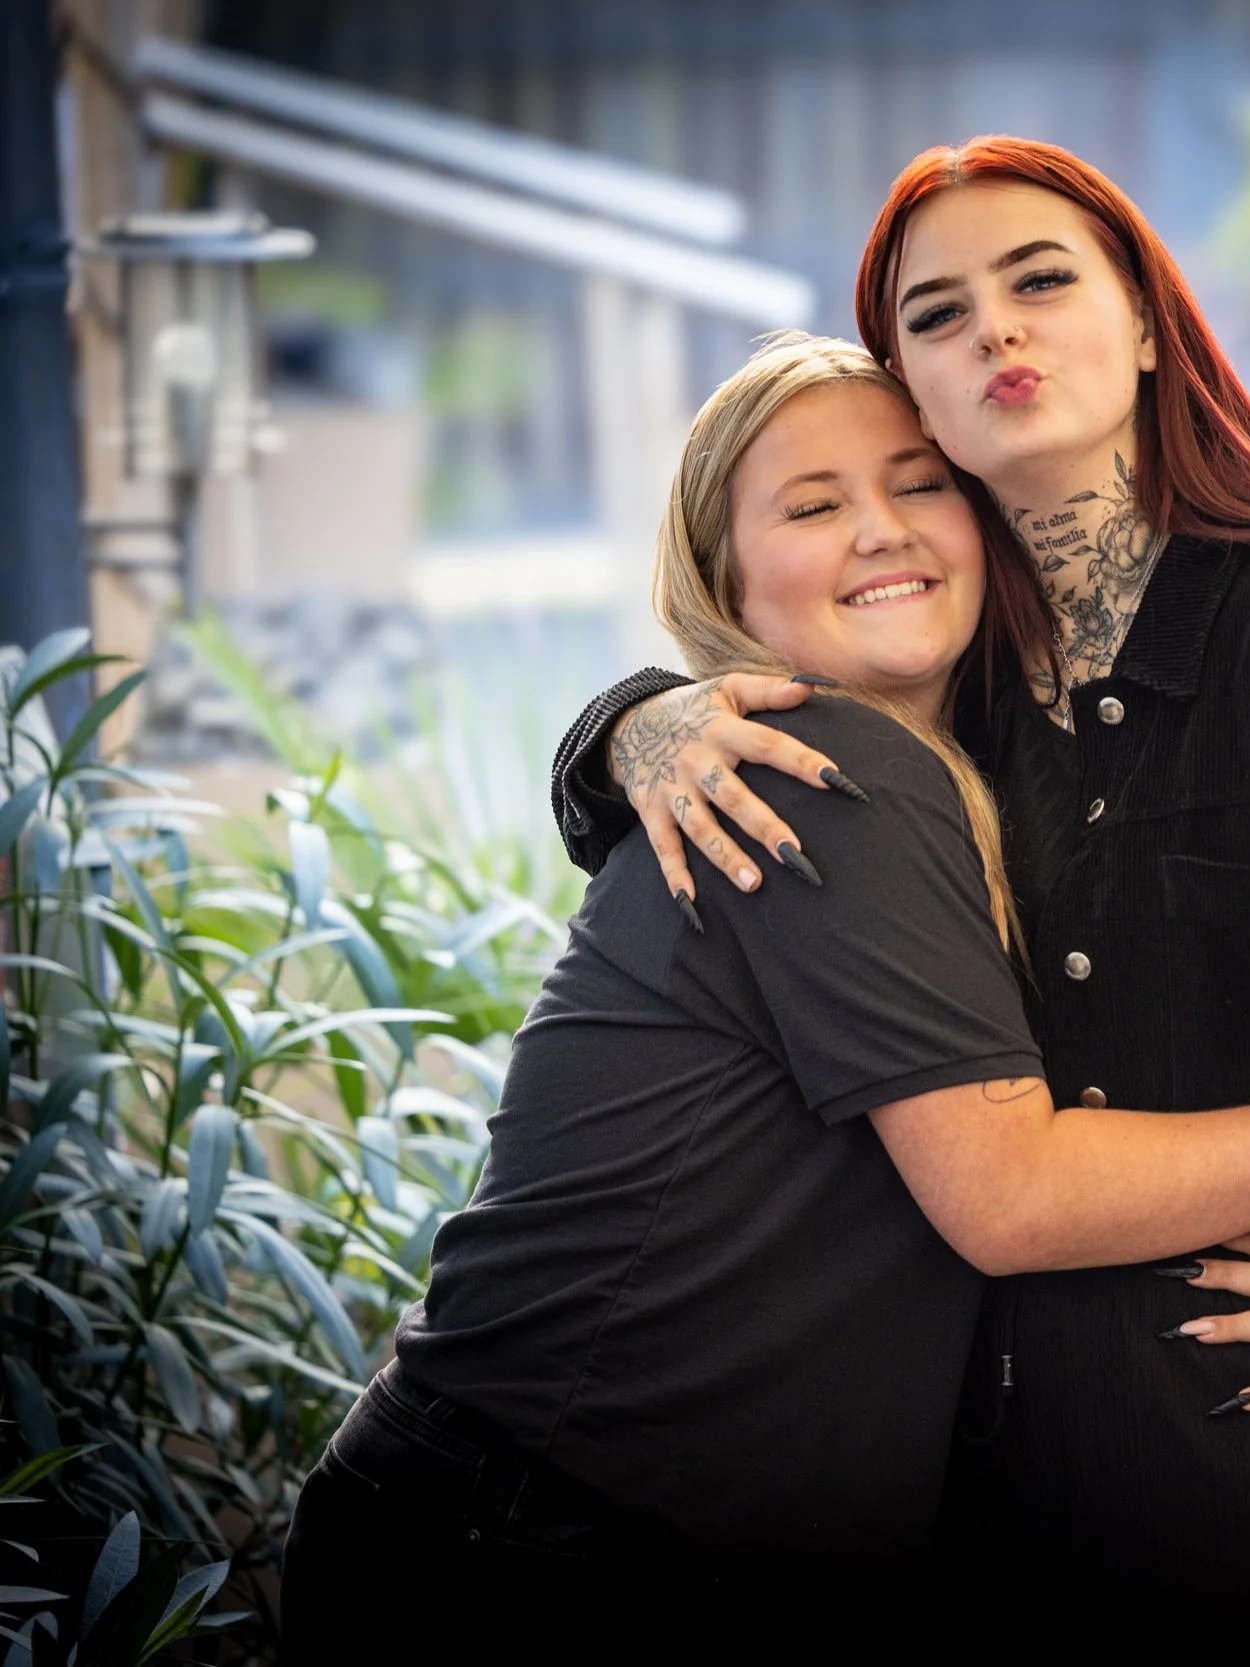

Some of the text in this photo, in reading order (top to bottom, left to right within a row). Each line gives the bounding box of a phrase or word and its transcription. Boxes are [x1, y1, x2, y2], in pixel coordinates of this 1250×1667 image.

[1032, 511, 1077, 530] mi alma
[1033, 527, 1087, 553] mi familia
